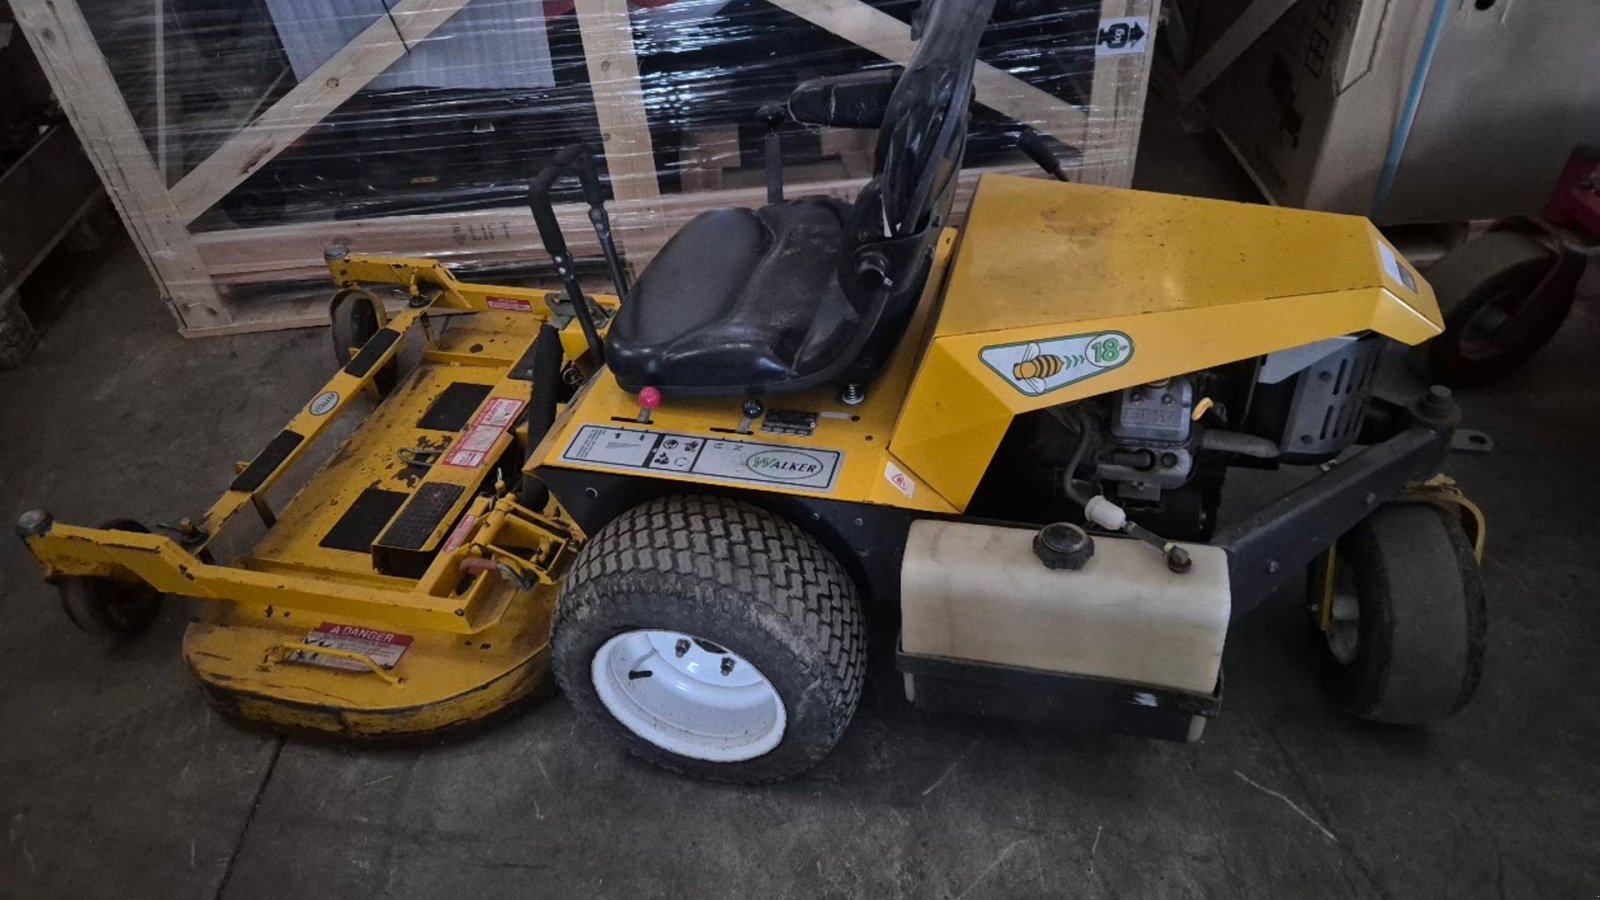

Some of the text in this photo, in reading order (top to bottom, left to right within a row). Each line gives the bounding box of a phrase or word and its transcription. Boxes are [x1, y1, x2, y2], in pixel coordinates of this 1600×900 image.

[1111, 28, 1125, 44] kg
[468, 221, 510, 240] LIFT
[1091, 338, 1119, 363] 18
[752, 456, 817, 473] WALKER
[341, 626, 395, 643] DANGER
